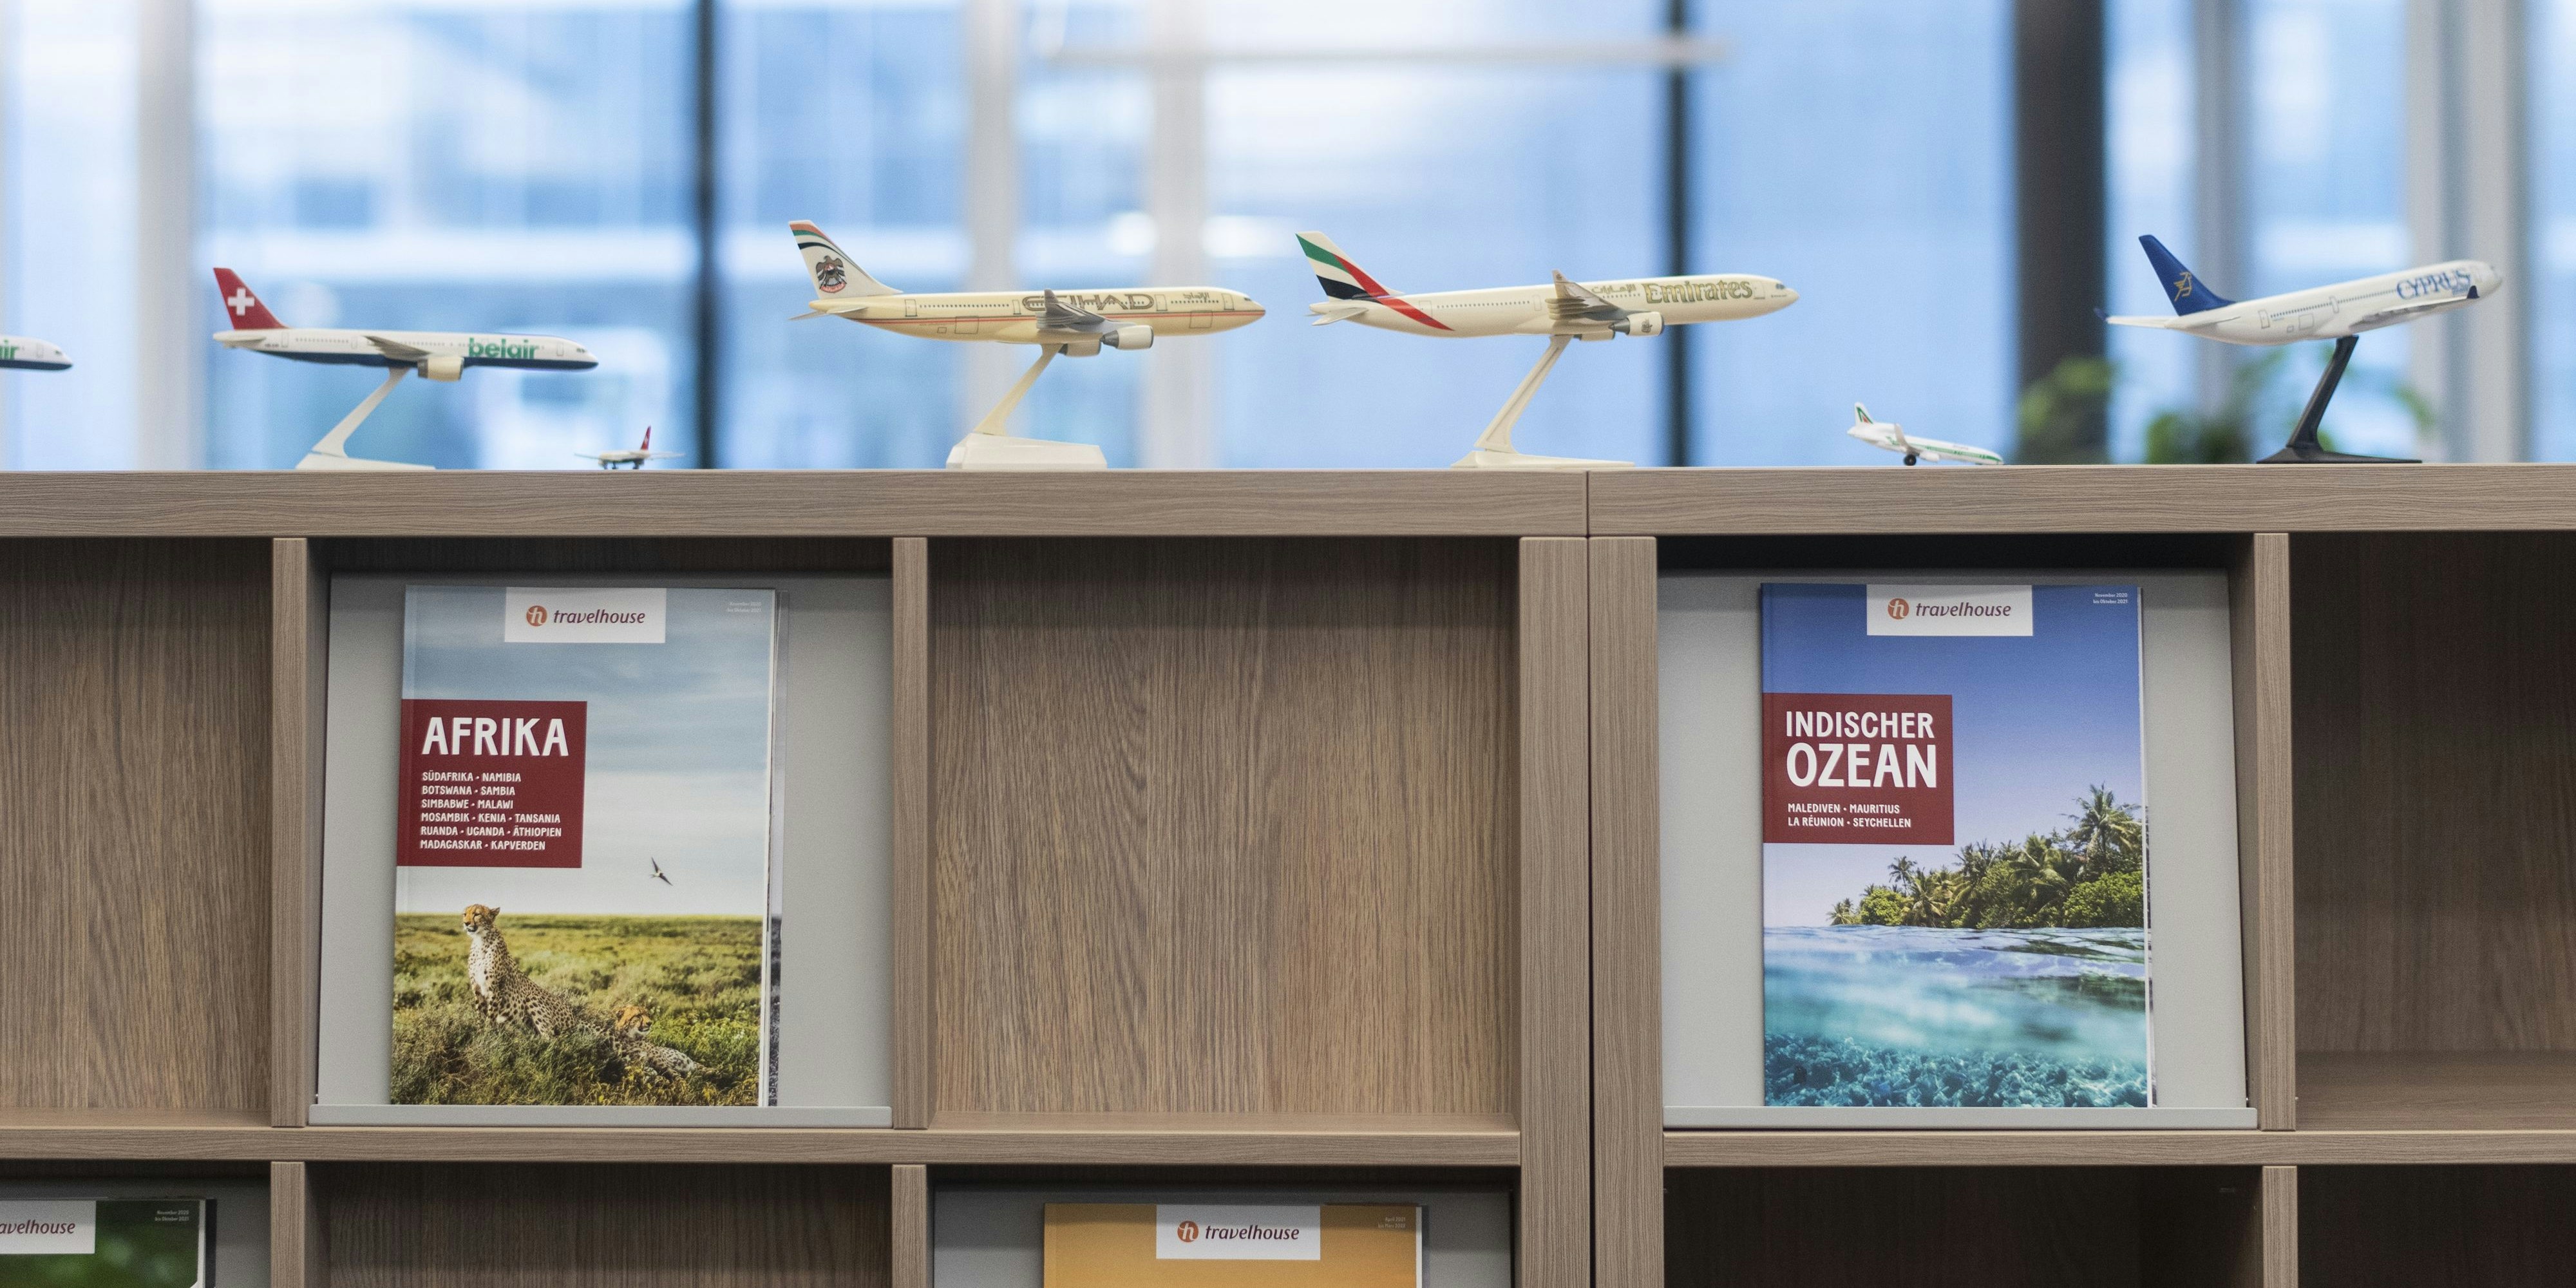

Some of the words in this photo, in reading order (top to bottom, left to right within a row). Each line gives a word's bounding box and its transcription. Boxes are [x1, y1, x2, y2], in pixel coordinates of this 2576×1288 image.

[2396, 269, 2470, 300] CYPRUS
[1642, 280, 1753, 304] Emirates
[469, 337, 540, 359] belair
[553, 609, 645, 623] travelhouse
[1916, 602, 2011, 616] travelhouse
[1786, 711, 1935, 738] INDISCHER
[422, 717, 569, 756] AFRIKA
[1786, 743, 1937, 788] OZEAN
[422, 770, 473, 781] SÜDAFRIKA
[482, 773, 521, 782] NAMIBIA
[422, 786, 472, 795] BOTSWANA
[481, 786, 515, 795] SAMBIA
[422, 799, 469, 808] SIMBABWE
[478, 800, 513, 809] MALAWI
[1788, 803, 1841, 813] MALEDIVEN
[1850, 804, 1900, 813] MAURITIUS
[421, 813, 469, 822] MOSAMBIK
[478, 813, 506, 822] KENIA
[515, 813, 560, 823] TANSANIA
[1788, 817, 1799, 826] LA
[1803, 815, 1844, 827] RÉUNION
[1853, 818, 1911, 828] SEYCHELLEN
[421, 826, 458, 835] RUANDA
[467, 827, 504, 836] UGANDA
[513, 825, 562, 837] ÄTHIOPIEN
[420, 840, 482, 849] MADAGASKAR
[491, 840, 545, 850] KAPVERDEN
[1206, 1225, 1300, 1240] travelhouse
